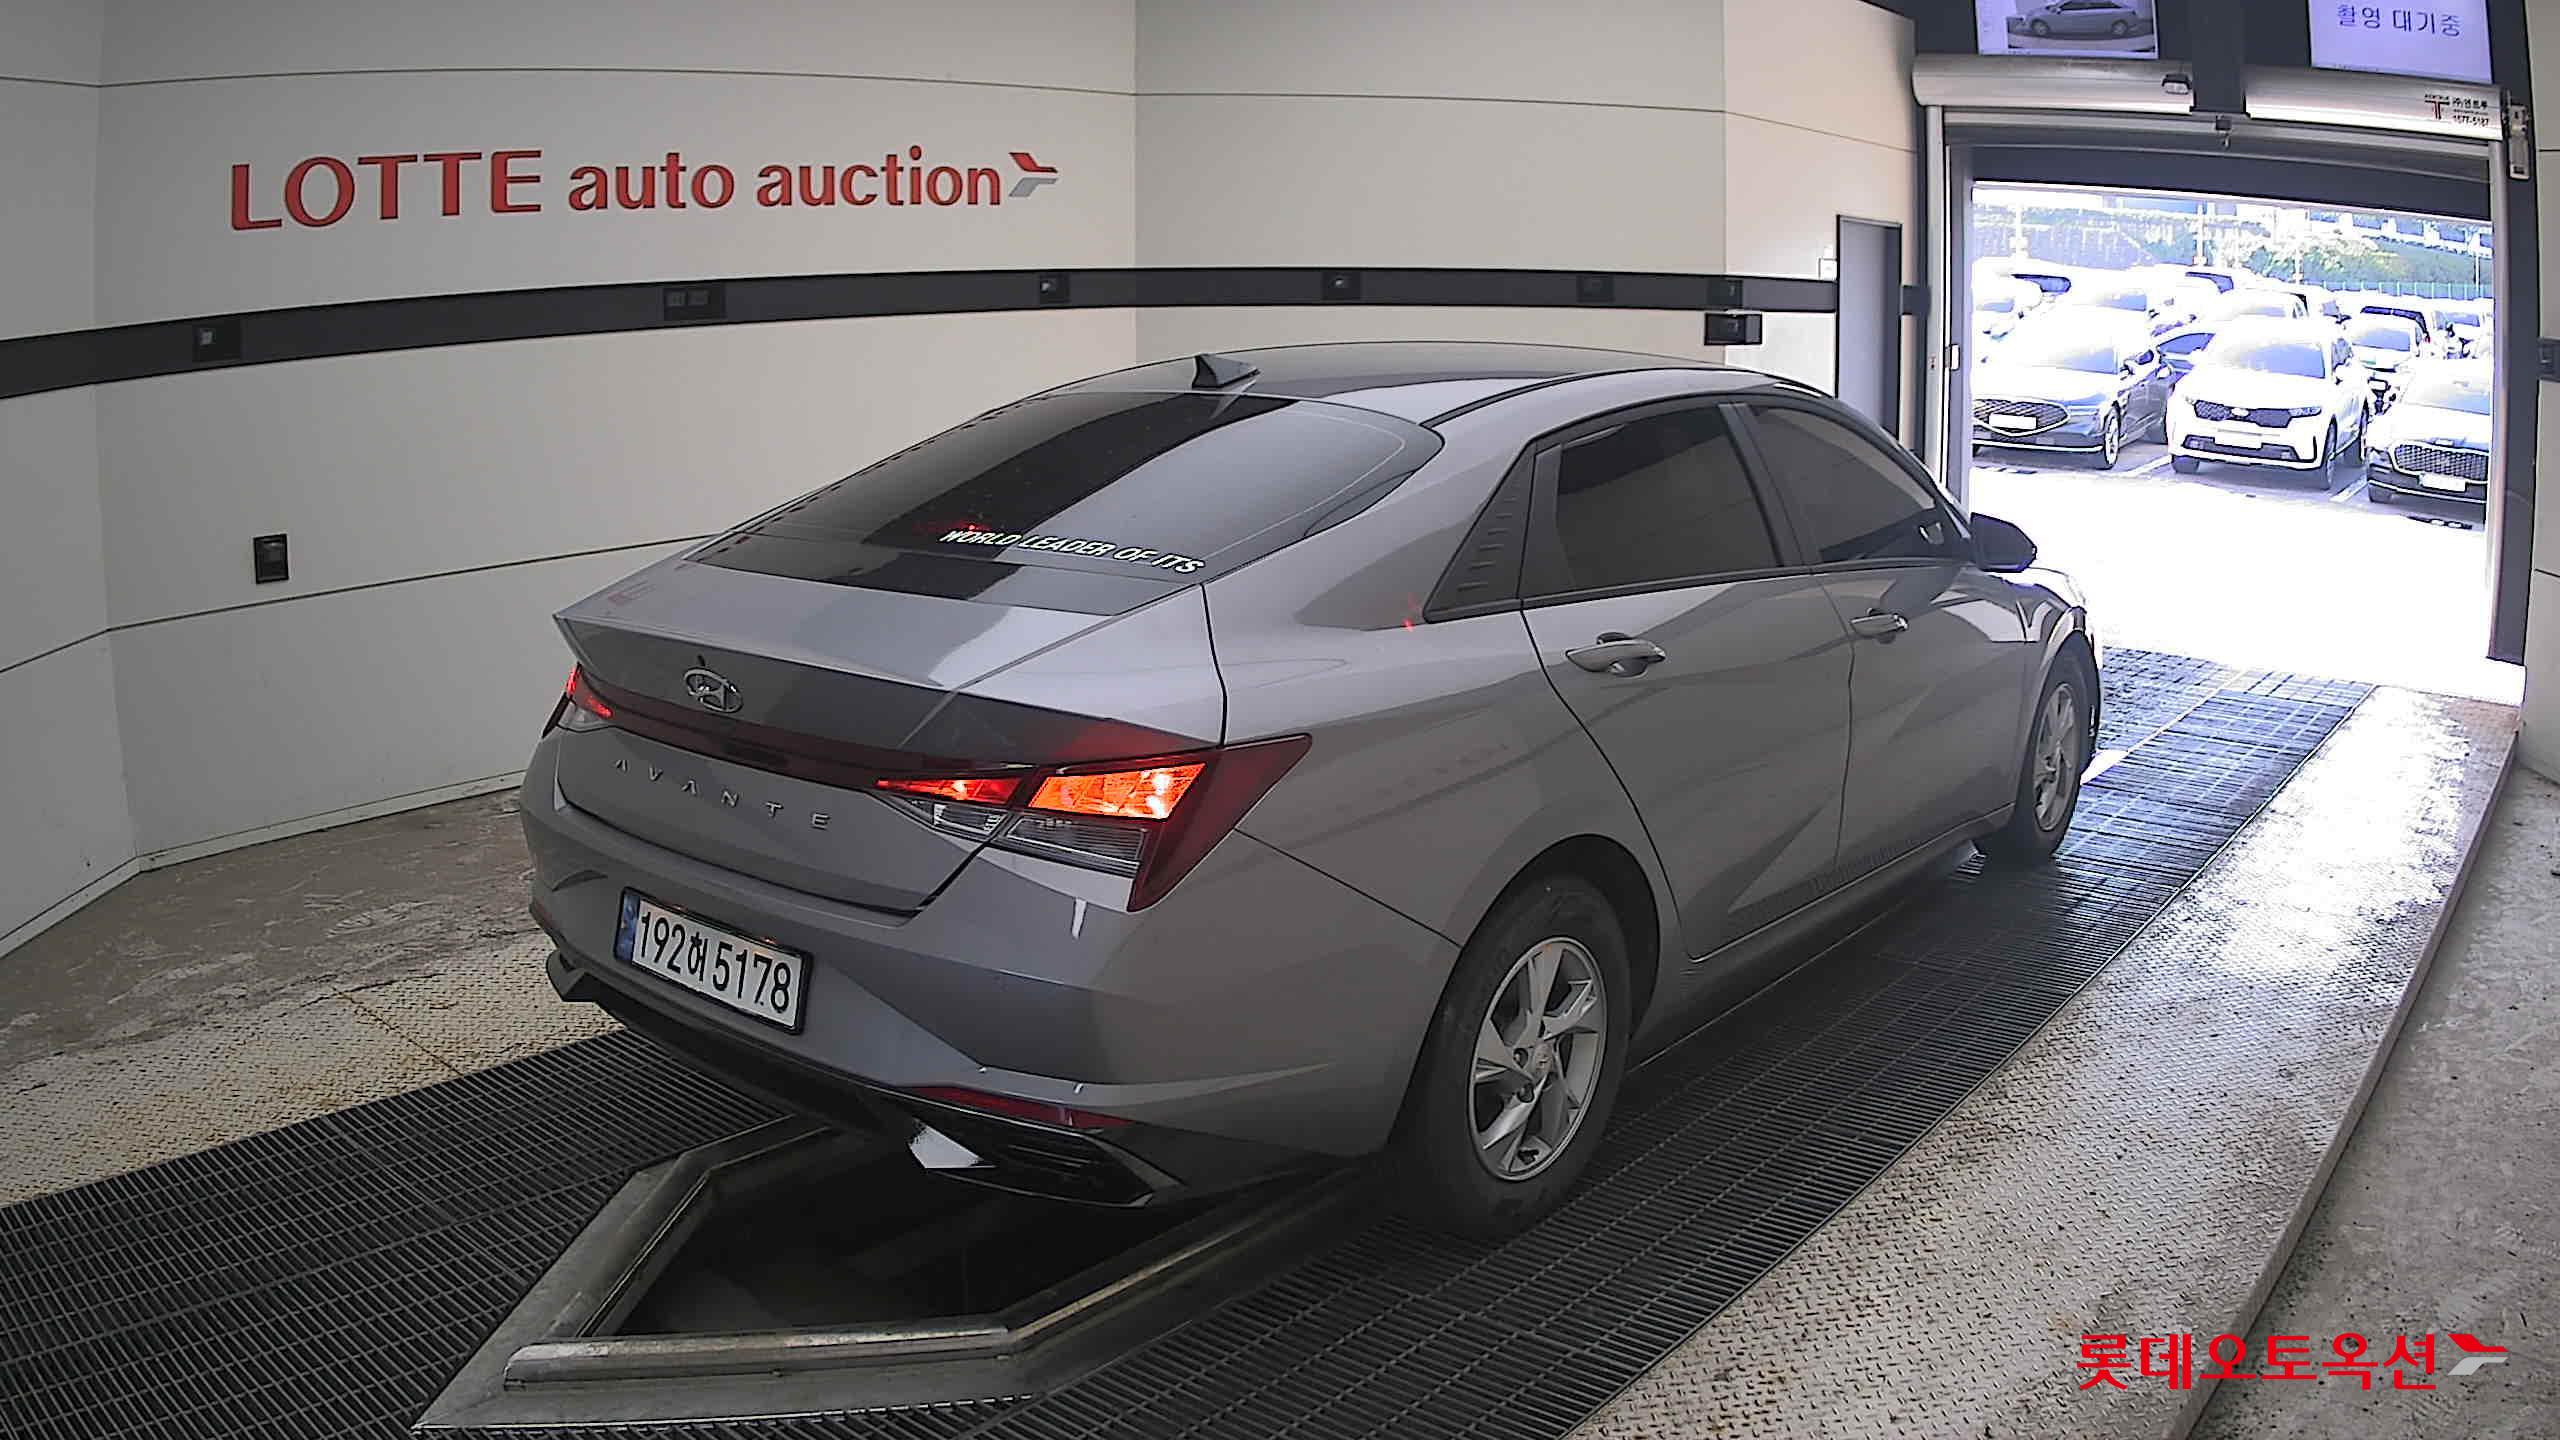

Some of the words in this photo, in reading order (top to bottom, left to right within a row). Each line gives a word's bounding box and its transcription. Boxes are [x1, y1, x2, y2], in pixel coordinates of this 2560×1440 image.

[2337, 4, 2381, 29] 촬영
[2392, 9, 2462, 37] 대기중
[231, 150, 543, 230] LOTTE
[569, 153, 735, 209] auto
[756, 145, 1003, 208] auction
[939, 530, 1022, 546] WORLD
[1018, 535, 1117, 558] LEADER
[1113, 547, 1159, 562] OF
[1151, 553, 1205, 574] ITS
[615, 759, 830, 830] AVANTE
[641, 911, 791, 1014] 192허5178
